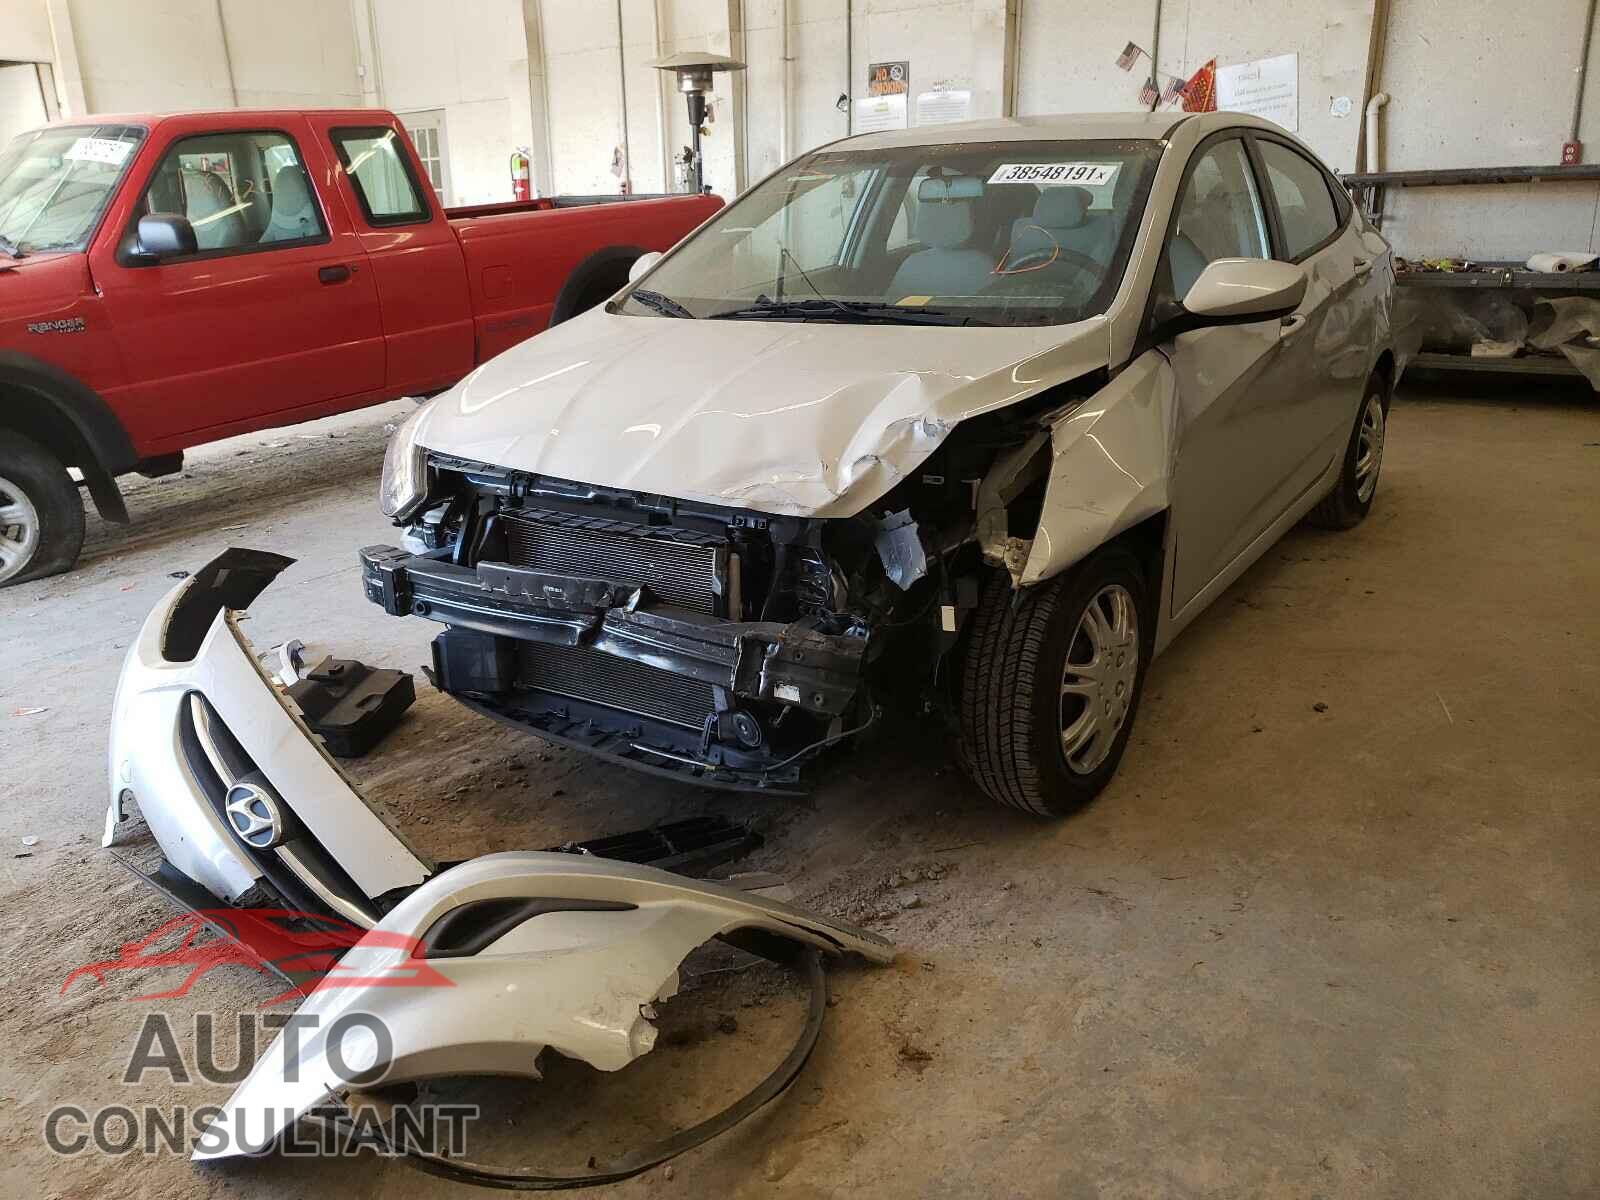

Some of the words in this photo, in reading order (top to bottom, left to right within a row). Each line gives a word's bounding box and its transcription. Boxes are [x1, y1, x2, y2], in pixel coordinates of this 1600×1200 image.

[874, 67, 888, 81] NO
[1006, 165, 1098, 181] 38548191
[27, 318, 85, 333] RANGER
